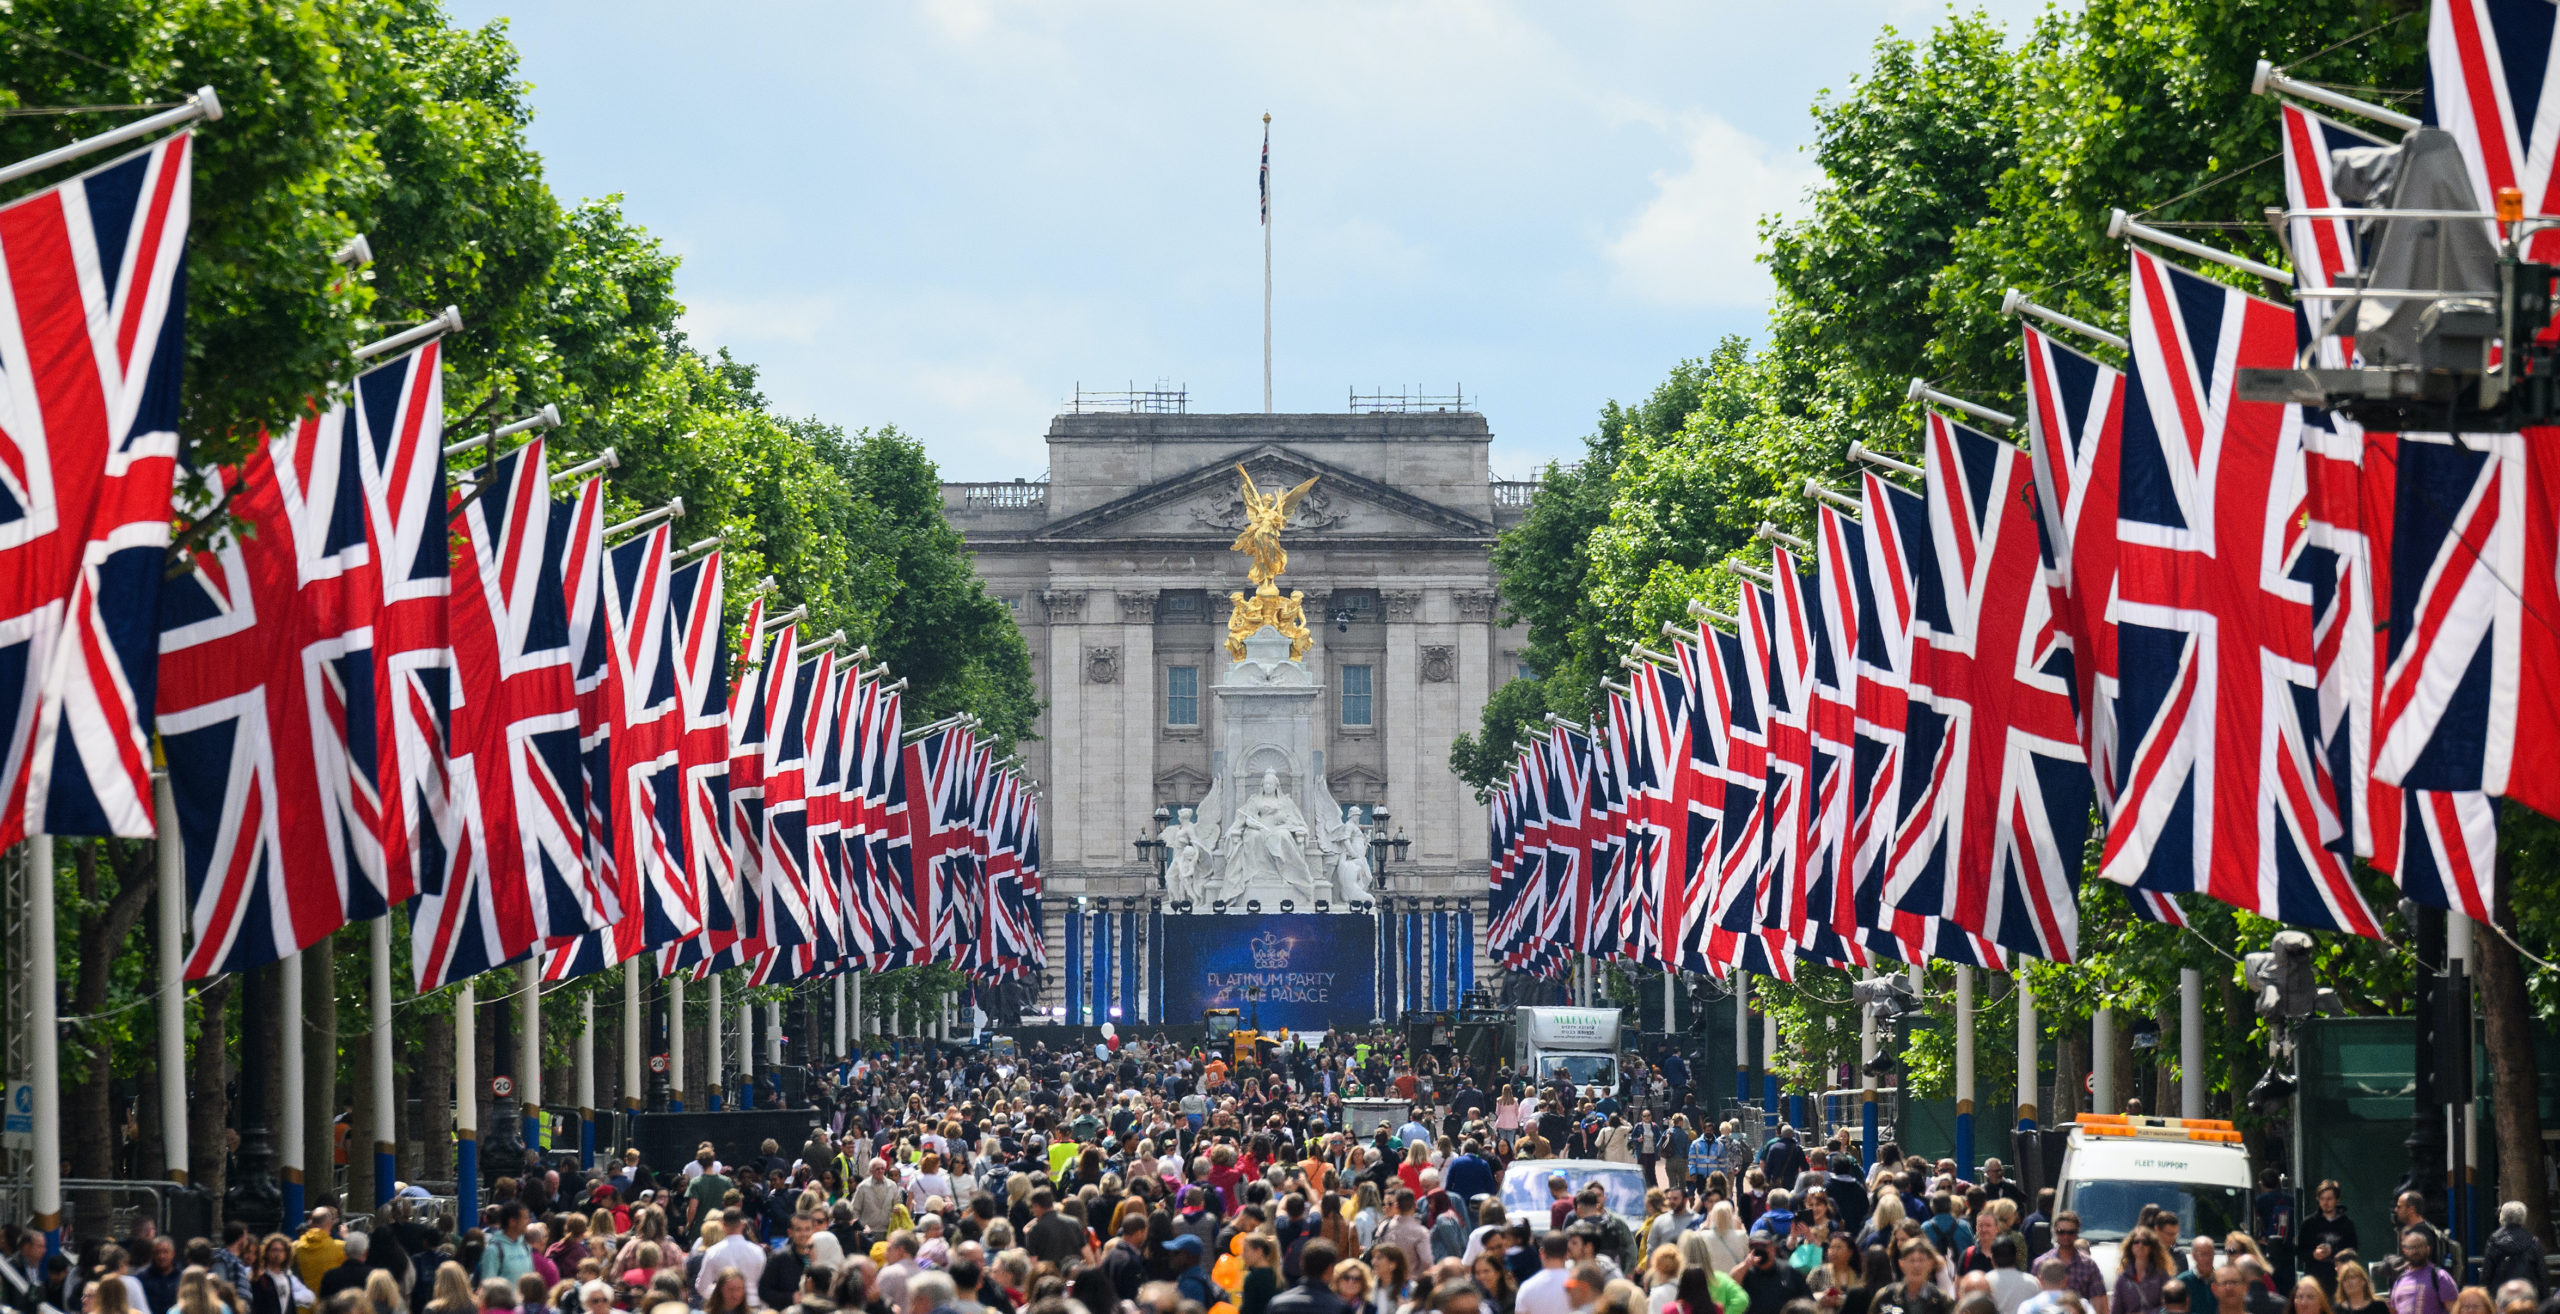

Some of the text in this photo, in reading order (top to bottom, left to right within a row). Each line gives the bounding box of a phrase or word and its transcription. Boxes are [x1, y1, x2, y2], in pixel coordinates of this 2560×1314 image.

[1208, 973, 1335, 987] PLATINUM PARTY
[1217, 989, 1232, 1002] AT
[1271, 988, 1329, 1003] PALACE
[652, 1060, 665, 1068] 20
[495, 1081, 510, 1091] 20
[2134, 1160, 2188, 1171] FLEET SUPPORT
